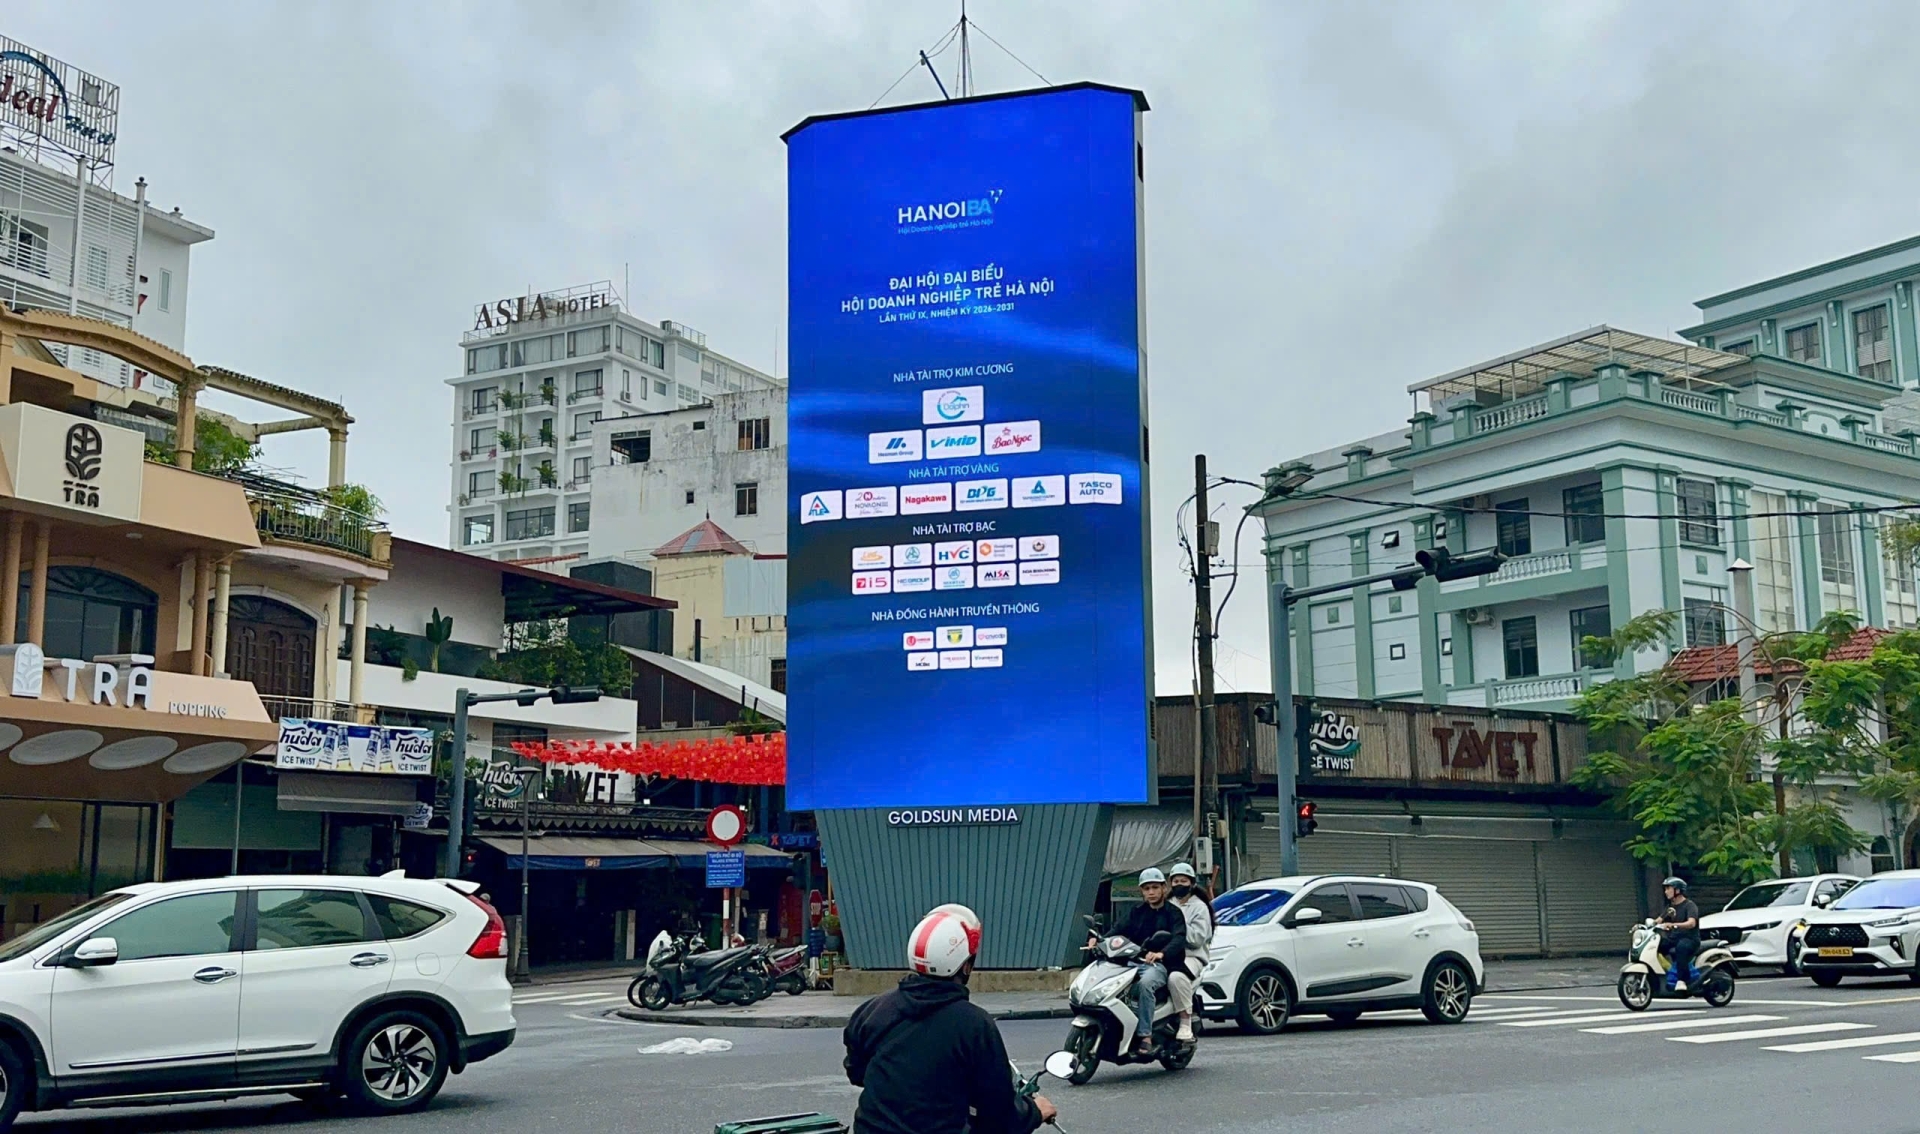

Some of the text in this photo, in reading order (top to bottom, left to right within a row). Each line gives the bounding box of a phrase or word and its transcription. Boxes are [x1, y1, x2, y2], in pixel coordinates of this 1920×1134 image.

[898, 198, 992, 224] HANOIBA
[889, 262, 1004, 292] ĐẠI HỘI ĐẠI BIỂU
[841, 277, 1055, 315] HỘI DOANH NGHIỆP TRẺ HÀ NỘI
[475, 294, 610, 330] ASIA HOTEL
[930, 306, 958, 319] NHIỆM
[973, 302, 1015, 315] 2026-2031
[893, 363, 1014, 383] NHÀ TÀI TRỢ KIM CƯƠNG
[908, 462, 1000, 479] NHÀ TÀI TRỢ VÀNG
[1079, 481, 1113, 489] TASCO
[1079, 488, 1104, 496] AUTO
[905, 495, 947, 505] Nagakawa
[912, 520, 997, 536] NHÀ TÀI TRỢ BẠC
[938, 546, 970, 561] HVC
[984, 569, 1010, 578] MISA
[871, 602, 1040, 621] NHÀ ĐỒNG HÀNH TRUYỀN THÔNG
[168, 701, 228, 719] POPPING
[1310, 711, 1360, 740] uda
[281, 755, 316, 766] ICE TWIST
[397, 763, 427, 772] ICE TWIST
[1324, 757, 1354, 770] TWIST
[484, 797, 518, 810] ICE TWIST
[888, 807, 1018, 824] GOLDSUN MEDIA
